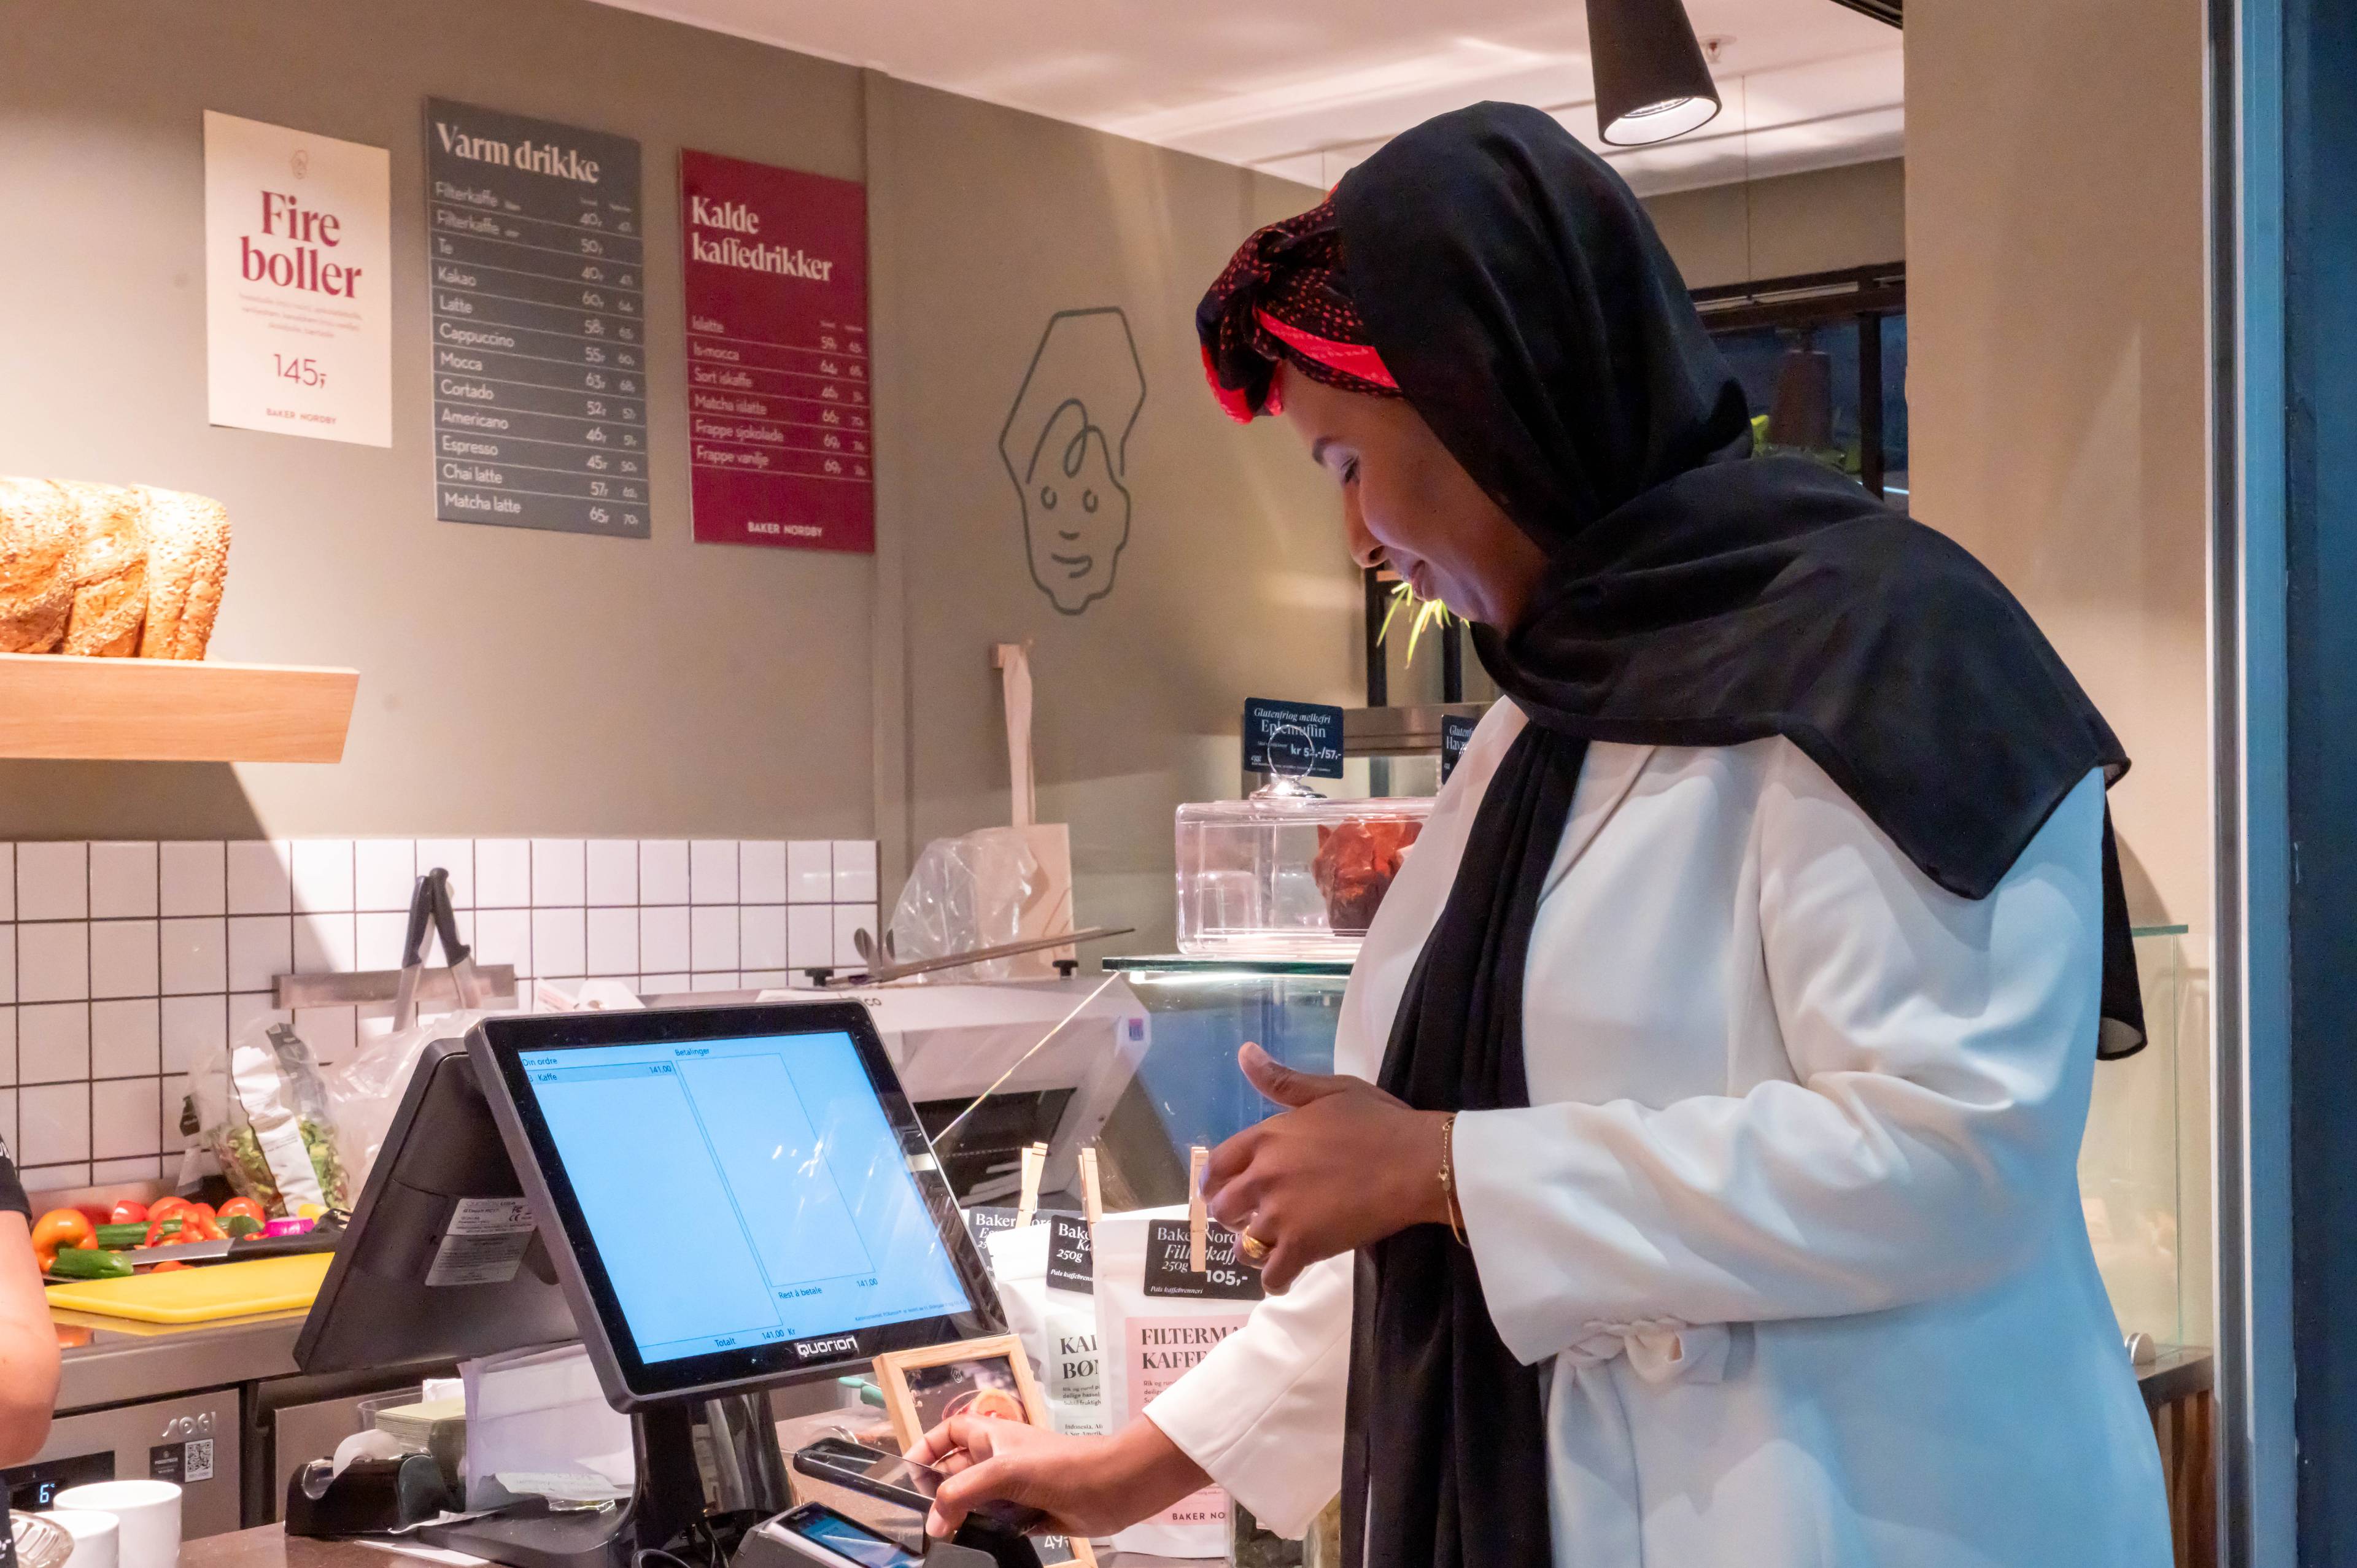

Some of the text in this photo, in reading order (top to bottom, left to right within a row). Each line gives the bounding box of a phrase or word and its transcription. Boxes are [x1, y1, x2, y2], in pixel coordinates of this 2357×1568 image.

[436, 123, 600, 183] Varm drikke
[261, 190, 340, 247] Fire
[692, 196, 759, 234] Kalde
[692, 232, 833, 281] kaffedrikker
[239, 235, 362, 299] boller
[438, 266, 476, 286] Kakao
[439, 295, 473, 313] Latte
[439, 323, 514, 347] Cappuccino
[441, 352, 482, 371] Mocca
[441, 379, 494, 400] Cortado
[266, 408, 336, 424] BAKER NORDBY
[442, 409, 508, 429] Americano
[442, 436, 498, 456] Espresso
[443, 463, 472, 479] Chai
[475, 467, 502, 484] latte
[445, 492, 491, 511] Matcha
[493, 496, 521, 513] latte
[748, 522, 822, 536] BAKER NORDBY
[1299, 714, 1331, 724] melkefri
[1449, 725, 1473, 738] Glutenf
[1291, 744, 1301, 755] kr
[675, 1048, 710, 1056] Betalinger
[522, 1058, 536, 1067] Din
[538, 1073, 558, 1081] Kaffe
[976, 1213, 1016, 1227] Baker
[1059, 1223, 1091, 1240] Bake
[1158, 1227, 1191, 1242] Bake
[1056, 1249, 1083, 1263] 250g
[1161, 1261, 1188, 1273] 250g
[1064, 1272, 1093, 1281] kaffebrenn
[1206, 1270, 1248, 1286] 105,-
[801, 1286, 822, 1296] betale
[714, 1337, 736, 1348] Totalt
[788, 1327, 796, 1336] Kr
[1142, 1326, 1239, 1346] FILTERM
